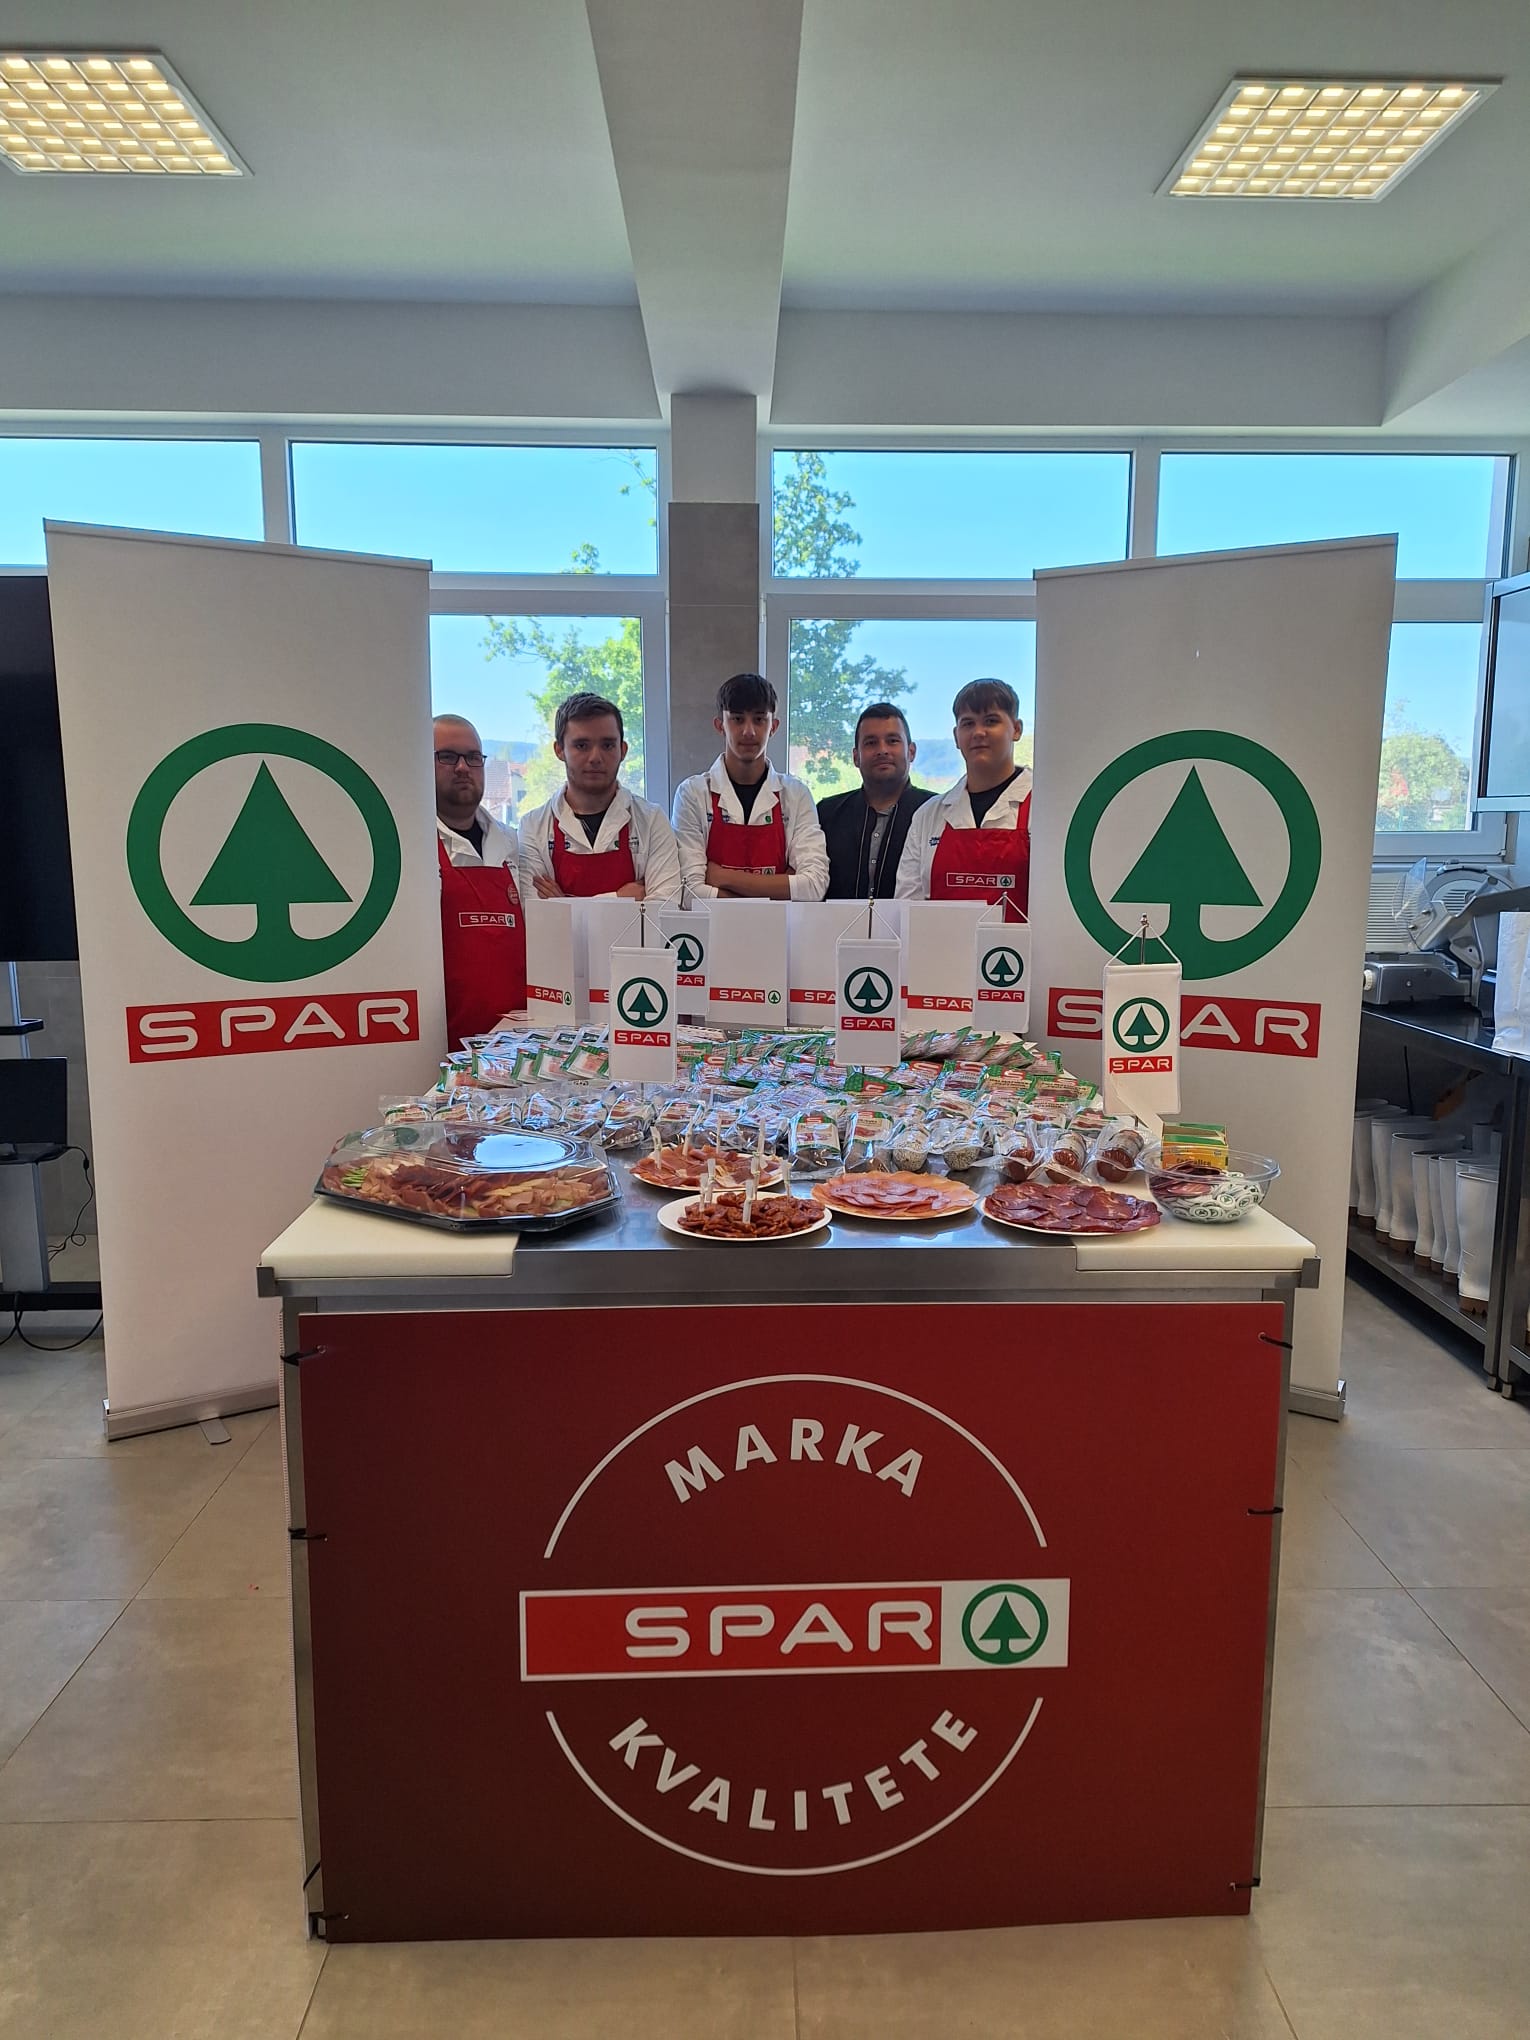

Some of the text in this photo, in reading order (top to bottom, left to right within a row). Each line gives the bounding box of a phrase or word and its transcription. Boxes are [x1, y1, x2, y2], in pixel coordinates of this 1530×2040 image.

[955, 875, 997, 886] SPAR
[469, 914, 506, 924] SPAR
[676, 975, 705, 985] PAR
[534, 988, 563, 1001] SPAR
[719, 989, 765, 1001] SPAR
[804, 991, 836, 1001] SPA
[979, 990, 1023, 1001] SPAR
[922, 997, 973, 1010] SPAR
[139, 998, 410, 1054] SPAR
[843, 1018, 894, 1031] SPAR
[1056, 994, 1310, 1051] SAR
[617, 1032, 670, 1047] SPAR
[1112, 1058, 1171, 1072] SPAR
[664, 1418, 924, 1503] MARKA
[625, 1601, 933, 1658] SPAR
[609, 1709, 978, 1831] KVALITETE
